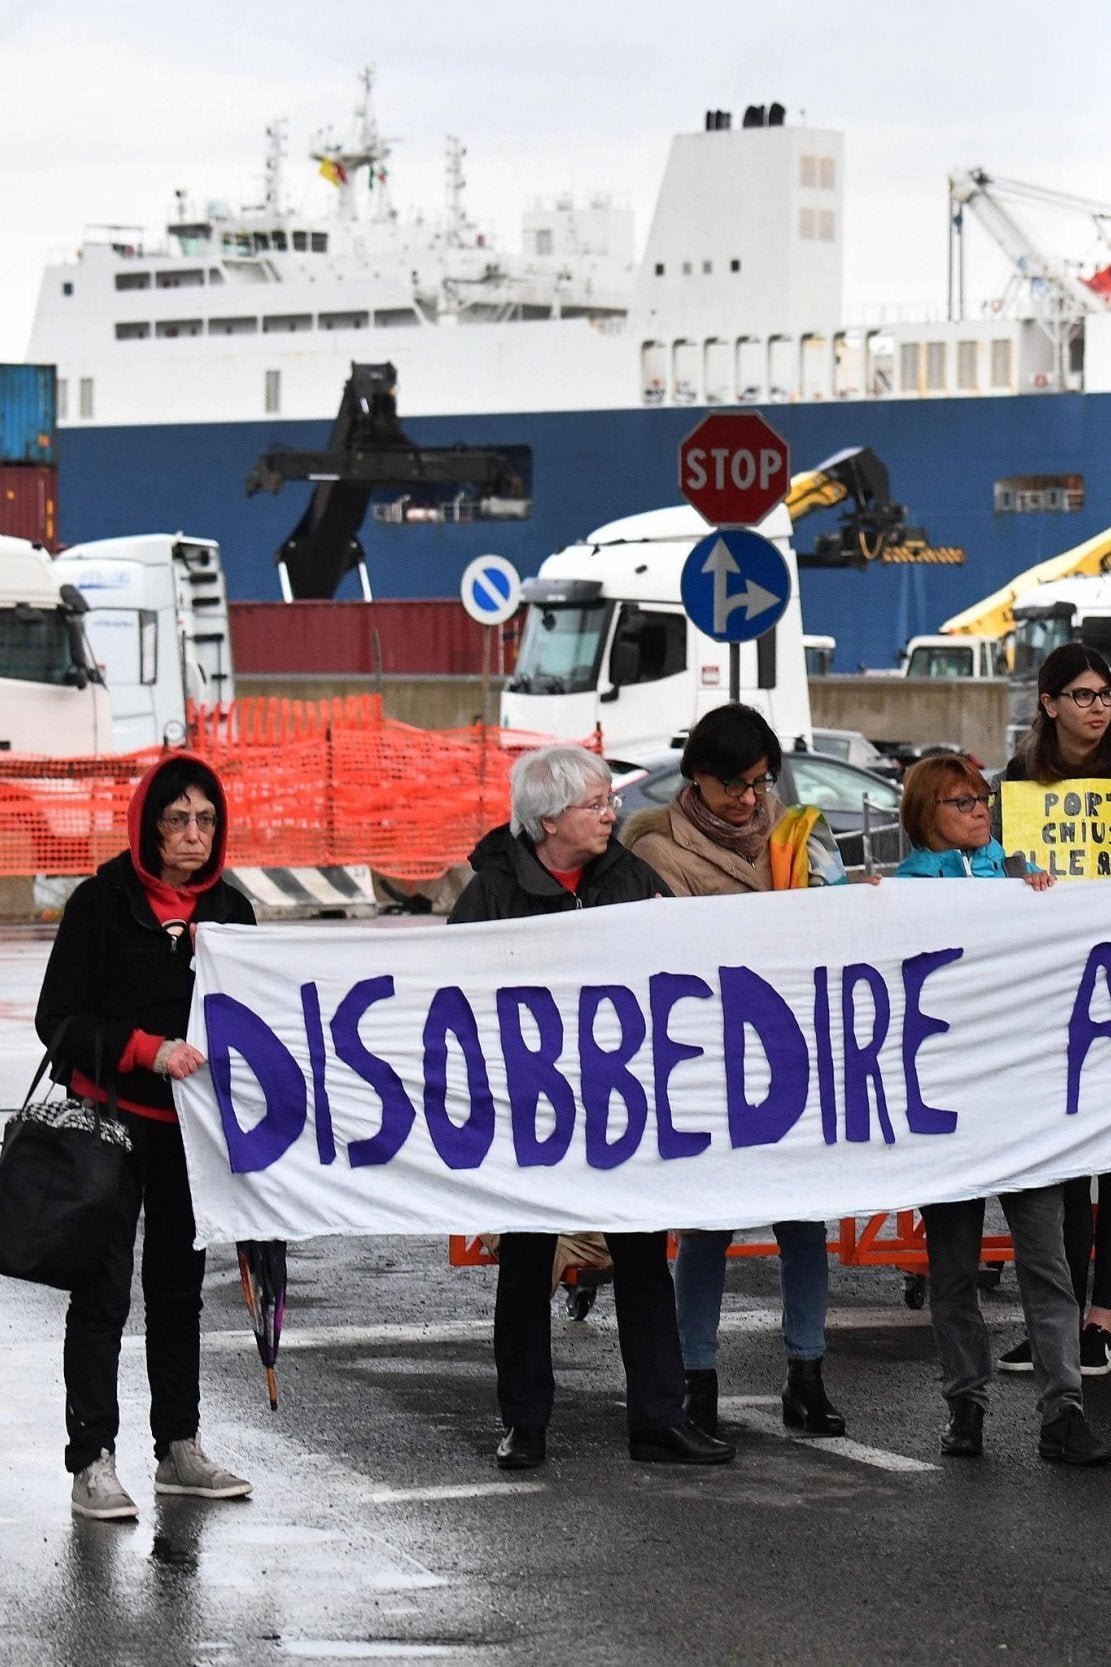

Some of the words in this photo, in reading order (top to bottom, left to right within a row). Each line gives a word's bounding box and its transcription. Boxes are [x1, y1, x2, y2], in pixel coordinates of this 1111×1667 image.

[686, 448, 782, 490] STOP
[1012, 849, 1087, 876] LE
[202, 947, 964, 1174] DISOBBEDIRE
